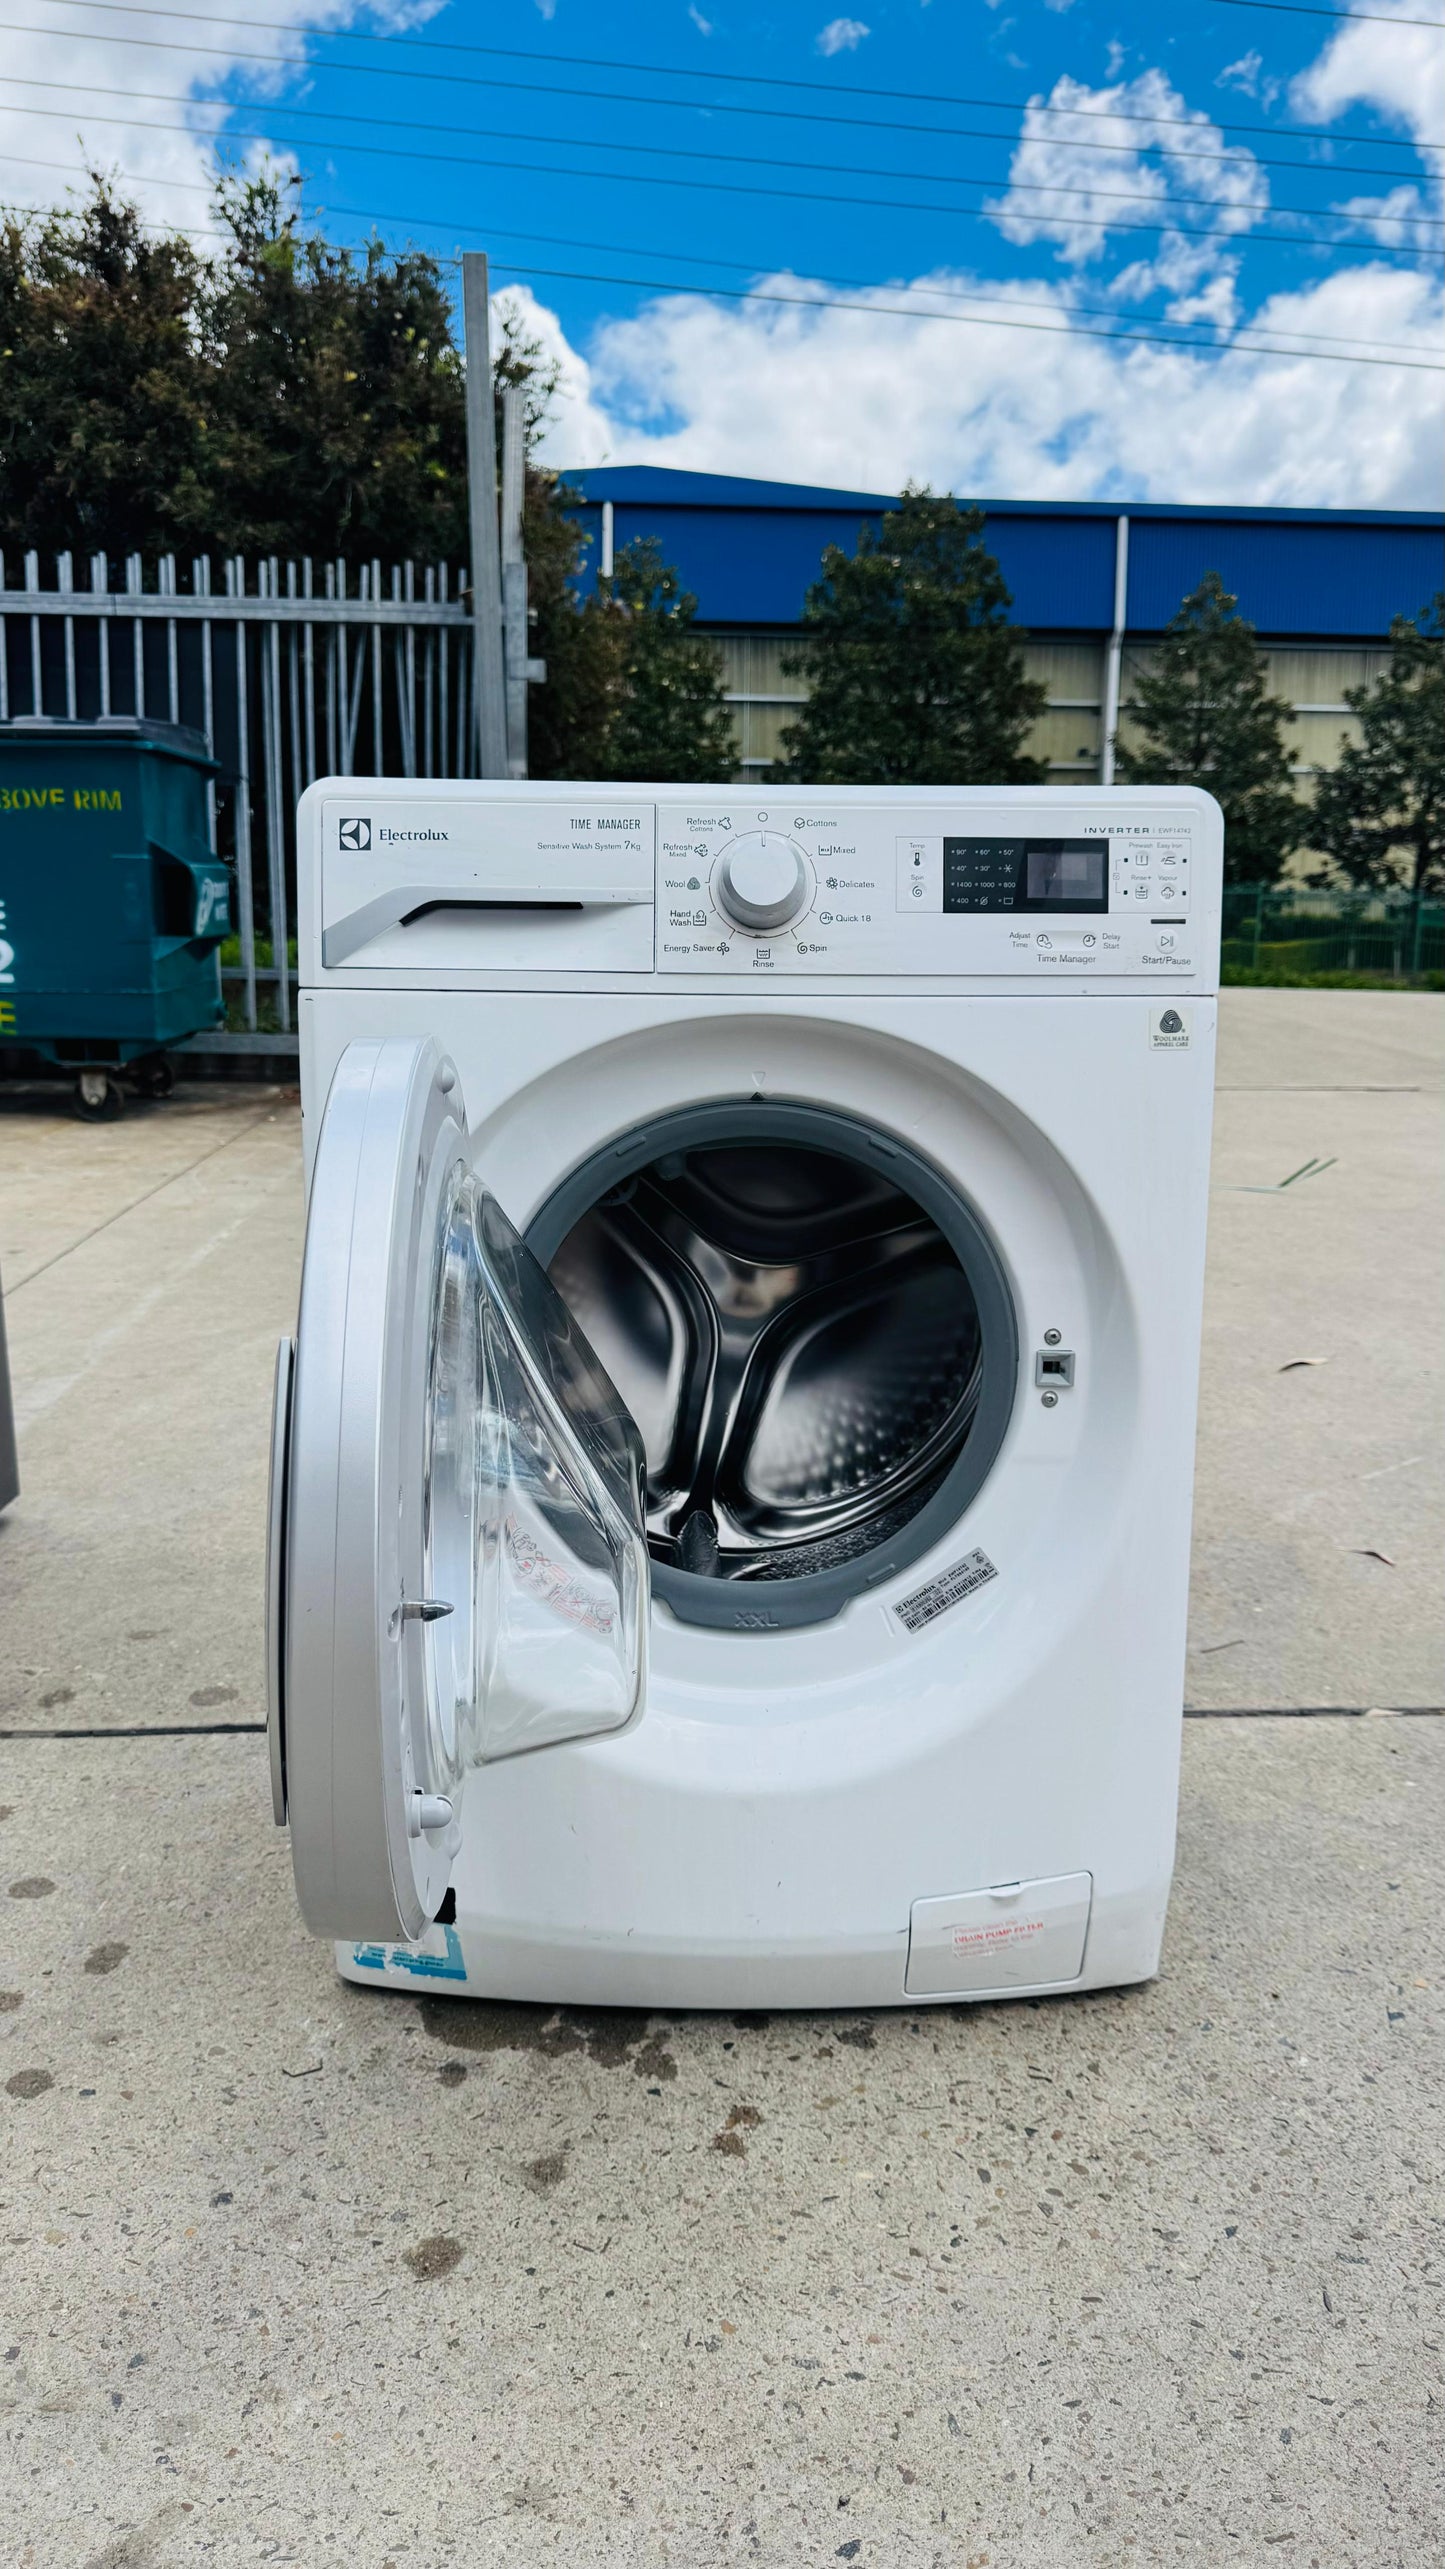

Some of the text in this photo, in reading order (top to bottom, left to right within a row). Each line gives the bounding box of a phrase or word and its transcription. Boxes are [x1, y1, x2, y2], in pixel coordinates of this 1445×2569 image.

[74, 790, 122, 811] RIM
[570, 819, 641, 830] TIME MANAGER
[379, 828, 448, 841] Electrolux
[538, 842, 570, 850] Sensitive
[594, 842, 622, 852] System
[624, 840, 641, 852] 7Kg
[665, 880, 686, 888] Wool
[670, 918, 692, 926] Wash
[836, 914, 858, 922] Quick
[1009, 931, 1030, 941] Adjust
[1102, 932, 1121, 942] Delay
[664, 944, 715, 954] Energy Saver
[809, 944, 828, 953] Spin
[752, 960, 774, 968] Rinse
[1037, 954, 1096, 965] Time Manager
[1142, 956, 1192, 966] Start/Pause
[902, 1584, 936, 1608] Electrolux
[735, 1610, 780, 1628] XXL
